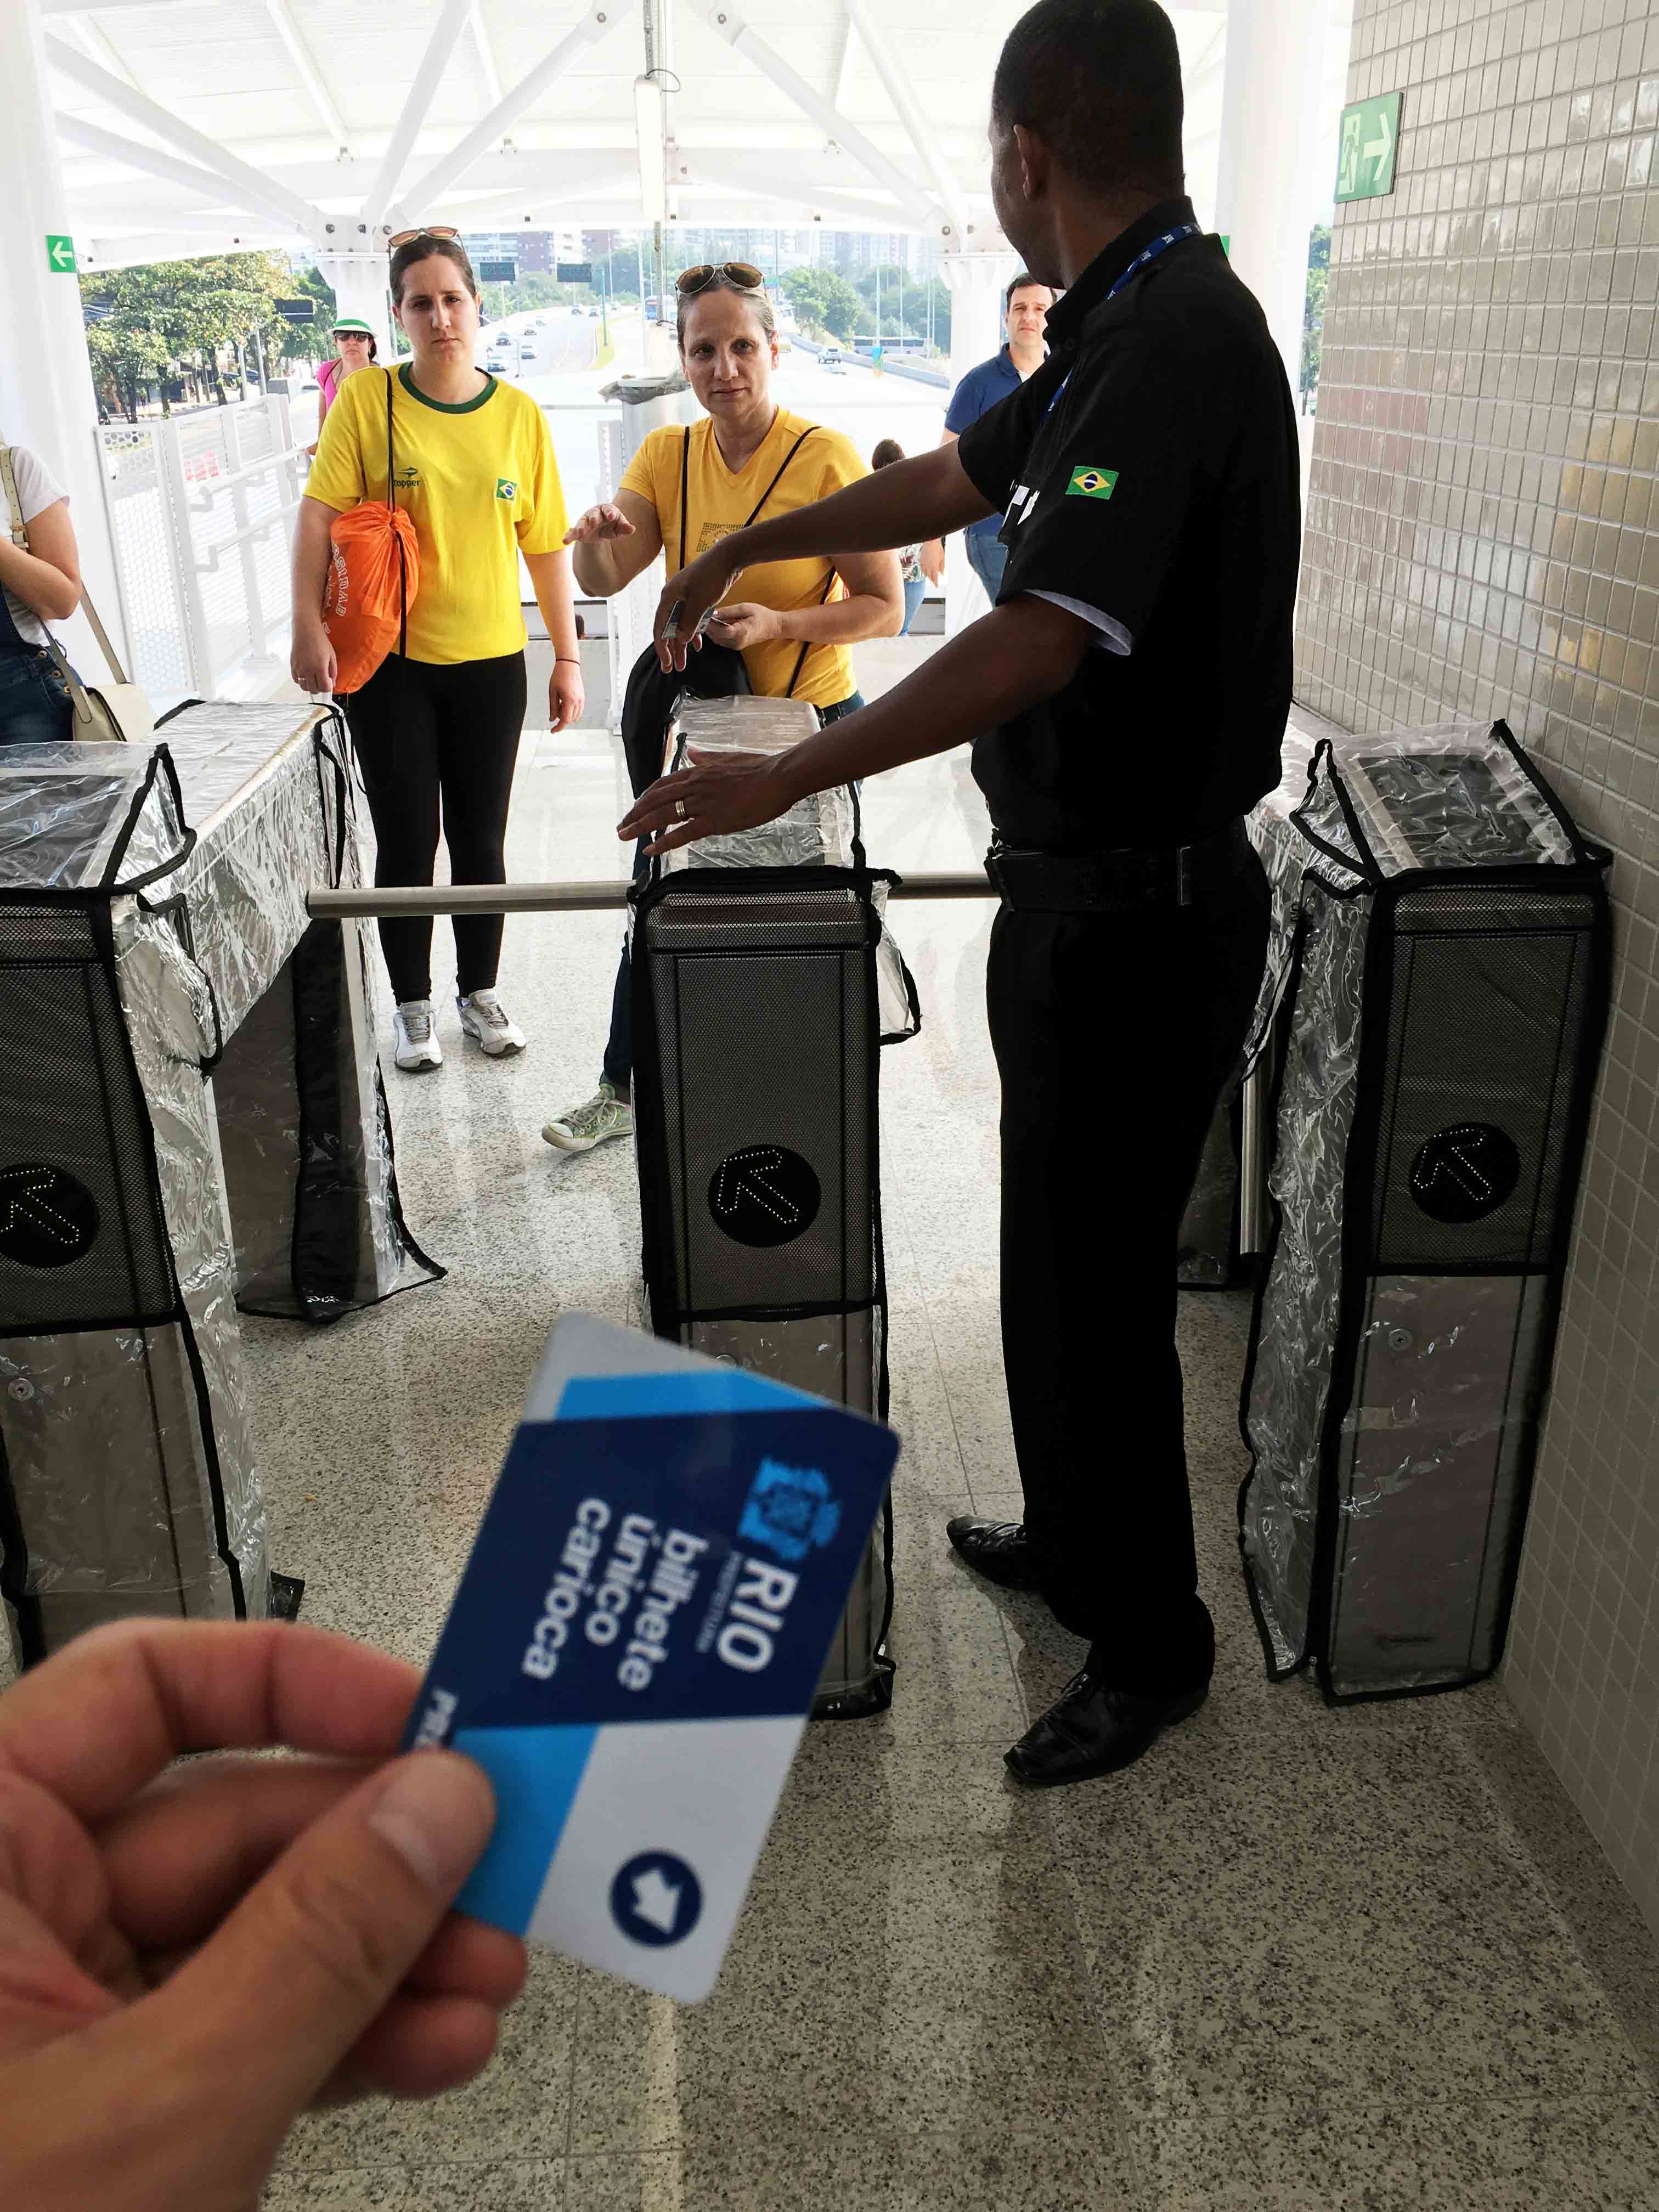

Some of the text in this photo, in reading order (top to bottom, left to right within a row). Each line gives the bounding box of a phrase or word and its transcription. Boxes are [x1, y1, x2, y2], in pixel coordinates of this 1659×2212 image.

[522, 1498, 611, 1679] carioca
[585, 1514, 662, 1645] único
[618, 1529, 709, 1690] bilhete
[717, 1558, 798, 1672] RIO
